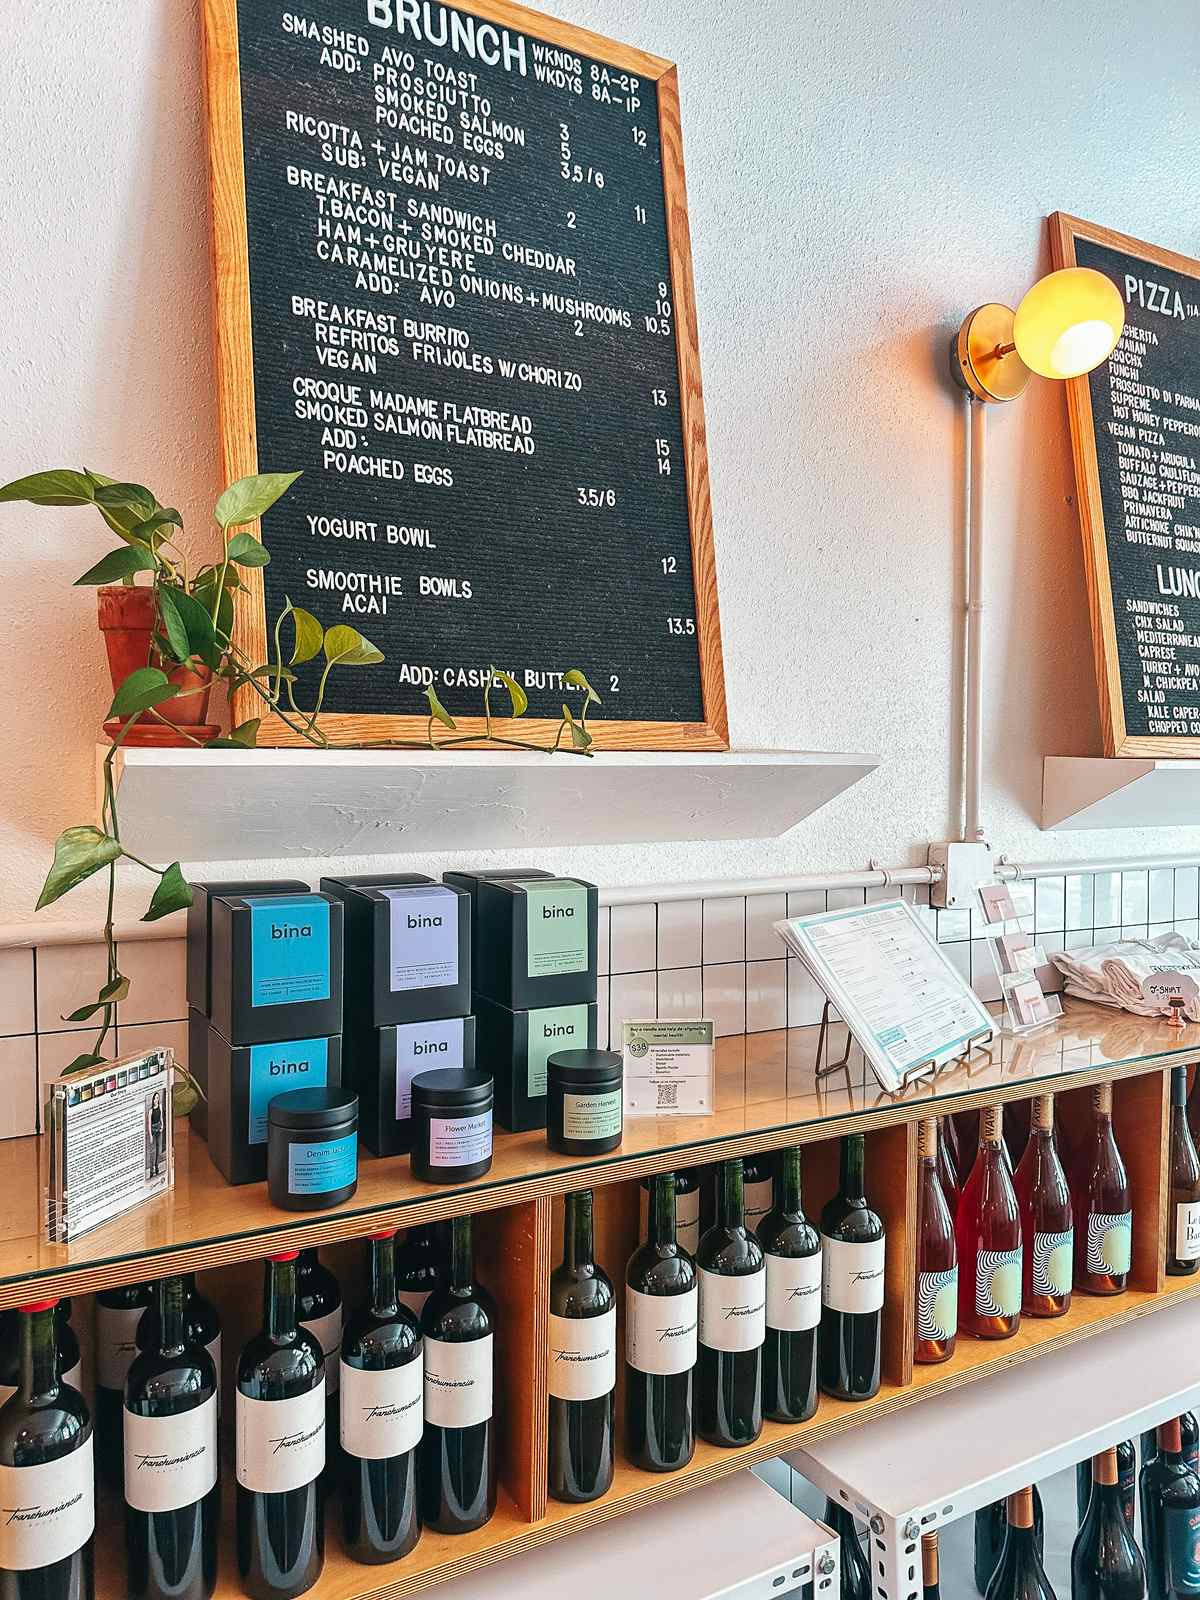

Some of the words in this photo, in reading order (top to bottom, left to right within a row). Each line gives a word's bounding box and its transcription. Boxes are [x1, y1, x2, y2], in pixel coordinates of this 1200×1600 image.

[367, 0, 528, 77] BRUNCH
[282, 13, 370, 57] SMASHED
[381, 46, 415, 72] AVO
[424, 59, 478, 93] TOAST
[631, 126, 647, 147] 12
[532, 43, 583, 76] WKNDS
[590, 64, 640, 94] 8A-2P
[533, 63, 583, 95] WKDYS
[320, 47, 362, 74] ADD:
[373, 63, 492, 118] PROSCIUTTO
[559, 123, 570, 141] 3
[374, 86, 449, 123] SMOKED
[460, 111, 526, 148] SALMON
[560, 142, 571, 161] 5
[376, 105, 454, 146] POACHED
[463, 134, 506, 161] EGGS
[285, 110, 364, 149] RICOTTA
[371, 138, 387, 156] +
[390, 142, 429, 169] JAM
[435, 154, 492, 186] TOAST
[634, 204, 646, 225] 11
[321, 143, 368, 170] SUB:
[378, 158, 441, 193] VEGAN
[566, 211, 577, 229] 2
[286, 167, 398, 210] BREAKFAST
[407, 199, 498, 239] SANDWICH
[421, 223, 495, 257] SMOKED
[502, 242, 577, 278] CHEDDAR
[658, 281, 667, 299] 9
[316, 240, 453, 288] CARAMELIZED
[644, 316, 671, 336] 10.5
[1124, 274, 1186, 320] PIZZA
[355, 271, 401, 297] ADD:
[420, 287, 457, 309] AVO
[573, 319, 584, 337] 2
[655, 299, 672, 318] 10
[291, 295, 397, 335] BREAKFAST
[403, 318, 470, 350] BURRITO
[315, 324, 400, 357] REFRITOS
[412, 345, 494, 376] FRIJOLES
[316, 346, 378, 376] VEGAN
[651, 388, 668, 407] 13
[1108, 361, 1139, 381] FUNGHI
[1109, 376, 1160, 400] PROSCIUTTO
[1163, 390, 1172, 404] DI
[1110, 390, 1151, 411] SUPREME
[293, 376, 363, 406] CROQUE
[370, 389, 439, 421] MADAME
[443, 402, 533, 436] FLATBREAD
[655, 438, 671, 457] 15
[1113, 405, 1130, 420] HOT
[1132, 408, 1160, 428] HONEY
[295, 399, 369, 430] SMOKED
[374, 411, 444, 441] SALMON
[447, 427, 536, 456] FLATBREAD
[657, 457, 672, 476] 14
[1107, 421, 1136, 440] VEGAN
[1139, 428, 1165, 446] PIZZA
[323, 451, 405, 481] POACHED
[414, 465, 454, 488] EGGS
[1117, 441, 1151, 460] TOMATO
[1160, 451, 1196, 470] ARUGULA
[1119, 455, 1156, 476] BUFFALO
[1121, 485, 1139, 501] BBQ
[1142, 490, 1185, 509] JACKFRUIT
[1123, 499, 1172, 520] PRIMAVERA
[1125, 514, 1170, 535] ARTICHOKE
[306, 515, 378, 543] YOGURT
[386, 525, 437, 549] BOWL
[661, 556, 677, 576] 12
[1126, 529, 1173, 549] BUTTERNUT
[306, 569, 402, 596] SMOOTHIE
[419, 575, 473, 599] BOWLS
[666, 616, 696, 636] 13.5
[342, 594, 387, 616] ACAI
[1126, 598, 1179, 617] SANDWICHES
[1135, 615, 1153, 629] CHX
[1156, 618, 1184, 632] SALAD
[1138, 645, 1177, 660] CAPRESE
[399, 663, 439, 686] ADD:
[609, 675, 620, 692] 2
[1141, 660, 1172, 675] TURKEY
[1185, 664, 1199, 677] AVO
[1137, 690, 1165, 704] SALAD
[1147, 705, 1170, 719] KALE
[1148, 720, 1187, 734] CHOPPED
[407, 913, 442, 929] bina
[542, 904, 574, 919] bina
[271, 923, 312, 940] bina
[543, 1022, 575, 1038] bina
[413, 1039, 448, 1056] bina
[269, 1060, 310, 1076] bina
